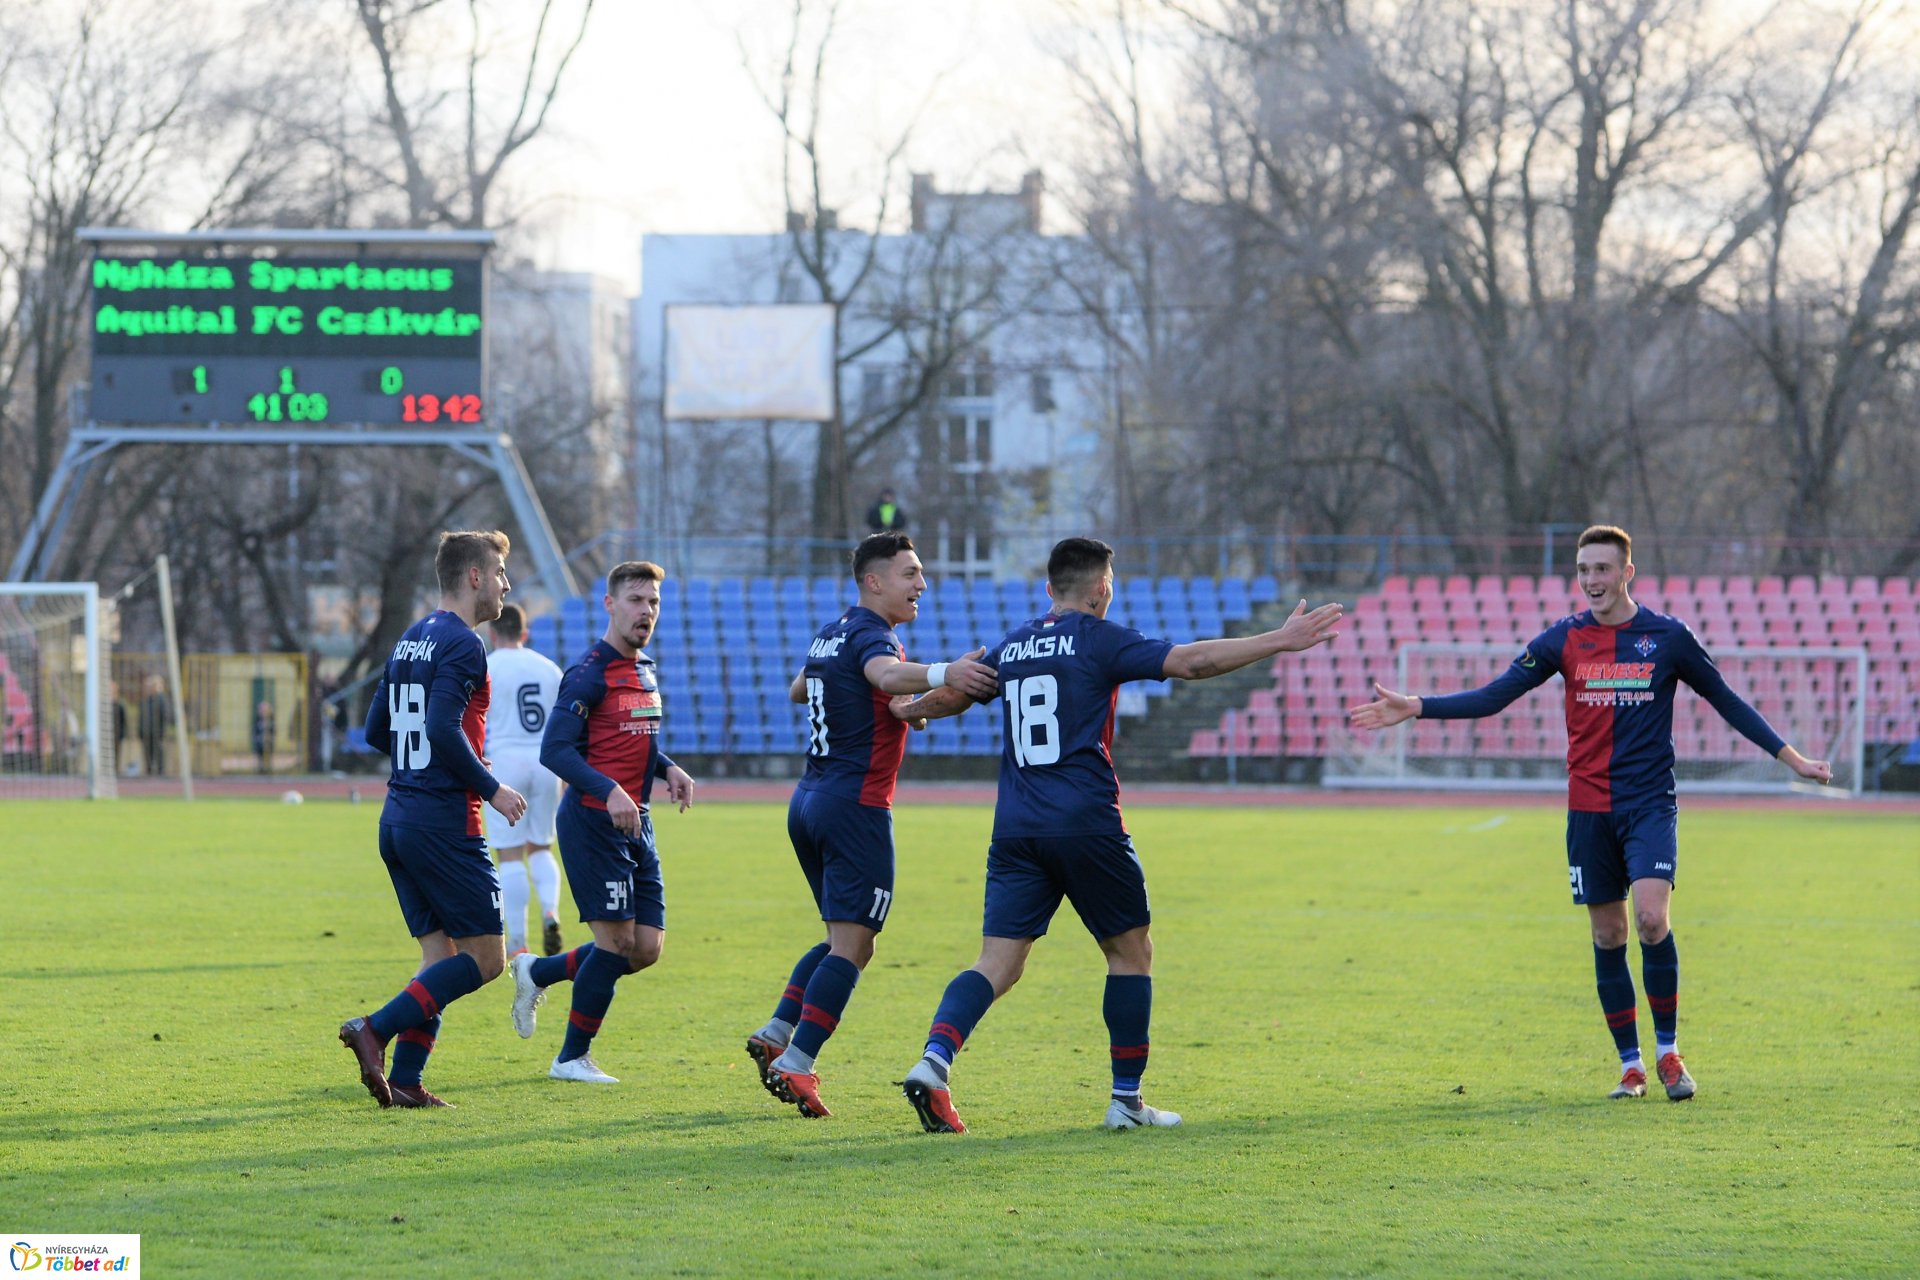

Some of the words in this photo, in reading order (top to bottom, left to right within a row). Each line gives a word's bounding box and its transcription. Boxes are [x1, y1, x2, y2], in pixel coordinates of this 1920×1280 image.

[93, 259, 234, 292] Nyháza
[250, 260, 453, 293] Spartacus
[253, 305, 303, 335] FC
[317, 306, 482, 337] Csákvár
[193, 365, 208, 394] 1
[279, 366, 295, 394] 1
[380, 366, 403, 395] 0
[1058, 635, 1076, 656] N.
[1575, 662, 1656, 681] REVESZ
[518, 683, 545, 733] 6
[1005, 674, 1061, 769] 18
[389, 683, 432, 770] 48
[1654, 861, 1672, 871] JAKO
[605, 881, 627, 911] 34
[868, 887, 891, 922] 11
